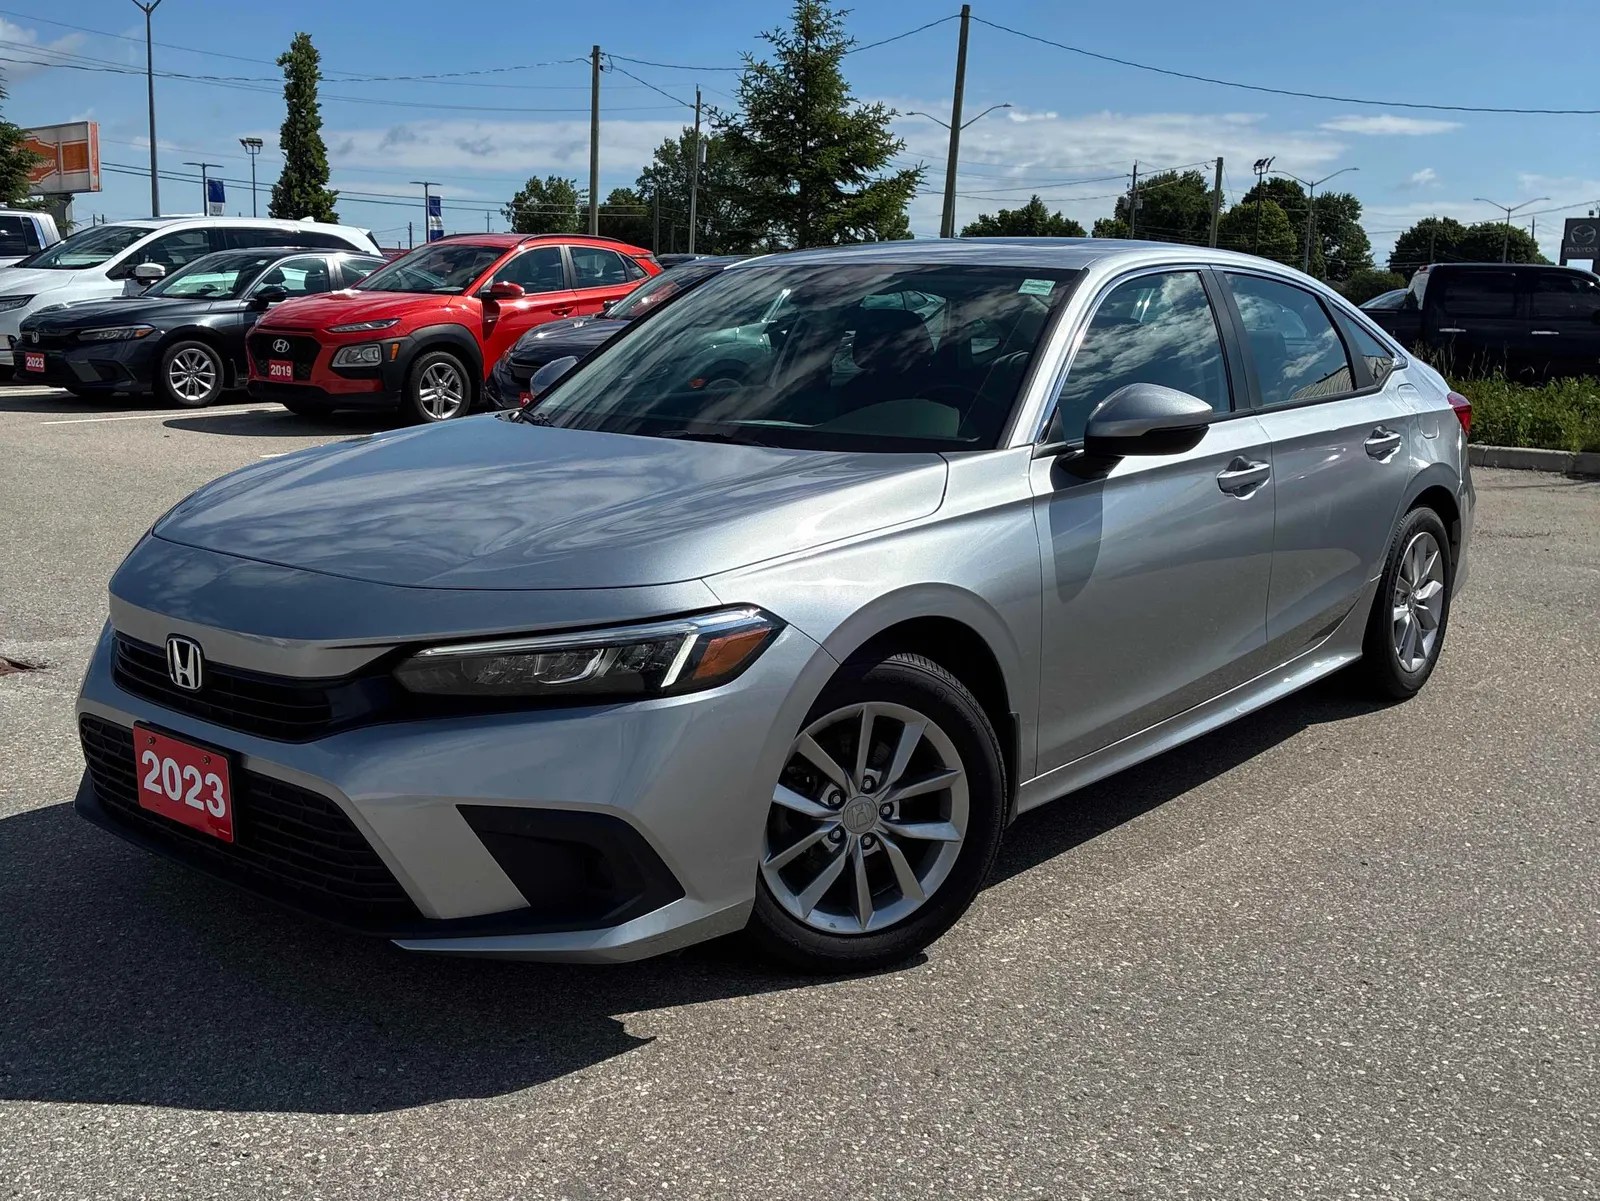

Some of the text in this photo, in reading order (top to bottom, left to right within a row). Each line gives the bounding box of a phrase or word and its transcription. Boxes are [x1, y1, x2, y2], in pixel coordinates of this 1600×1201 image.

[26, 356, 44, 368] 2023
[270, 364, 292, 377] 2019
[141, 750, 226, 818] 2023
